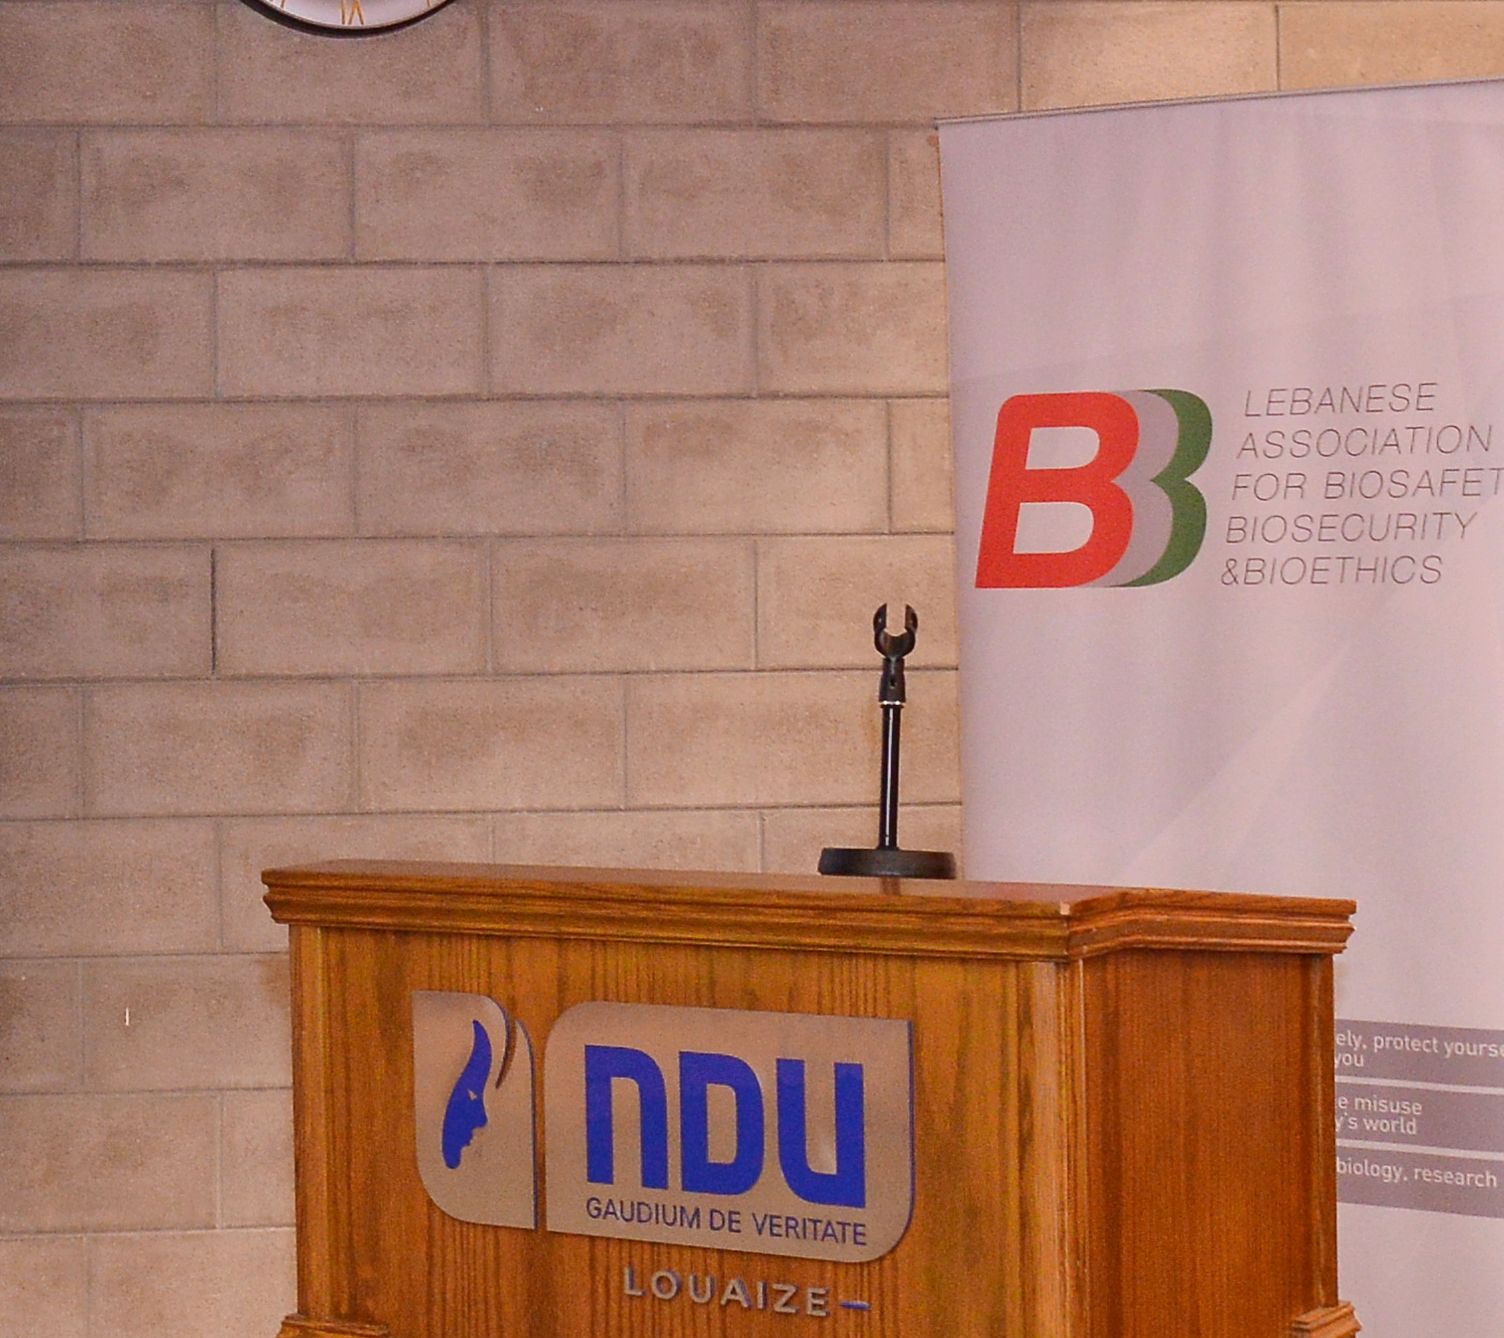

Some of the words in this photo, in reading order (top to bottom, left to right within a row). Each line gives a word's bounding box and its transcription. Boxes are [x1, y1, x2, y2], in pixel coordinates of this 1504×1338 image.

[1244, 382, 1439, 418] LEBANESE
[1236, 424, 1494, 460] ASSOCIATION
[1231, 472, 1306, 502] FOR
[1225, 511, 1479, 545] BIOSECURITY
[1220, 554, 1444, 588] &BIOETHICS
[1373, 1034, 1439, 1053] protect
[1354, 1094, 1422, 1115] misuse
[1363, 1117, 1417, 1135] world
[1414, 1167, 1498, 1188] research
[586, 1197, 701, 1229] GAUDIUM
[709, 1208, 742, 1233] DE
[752, 1213, 868, 1246] VERITATE
